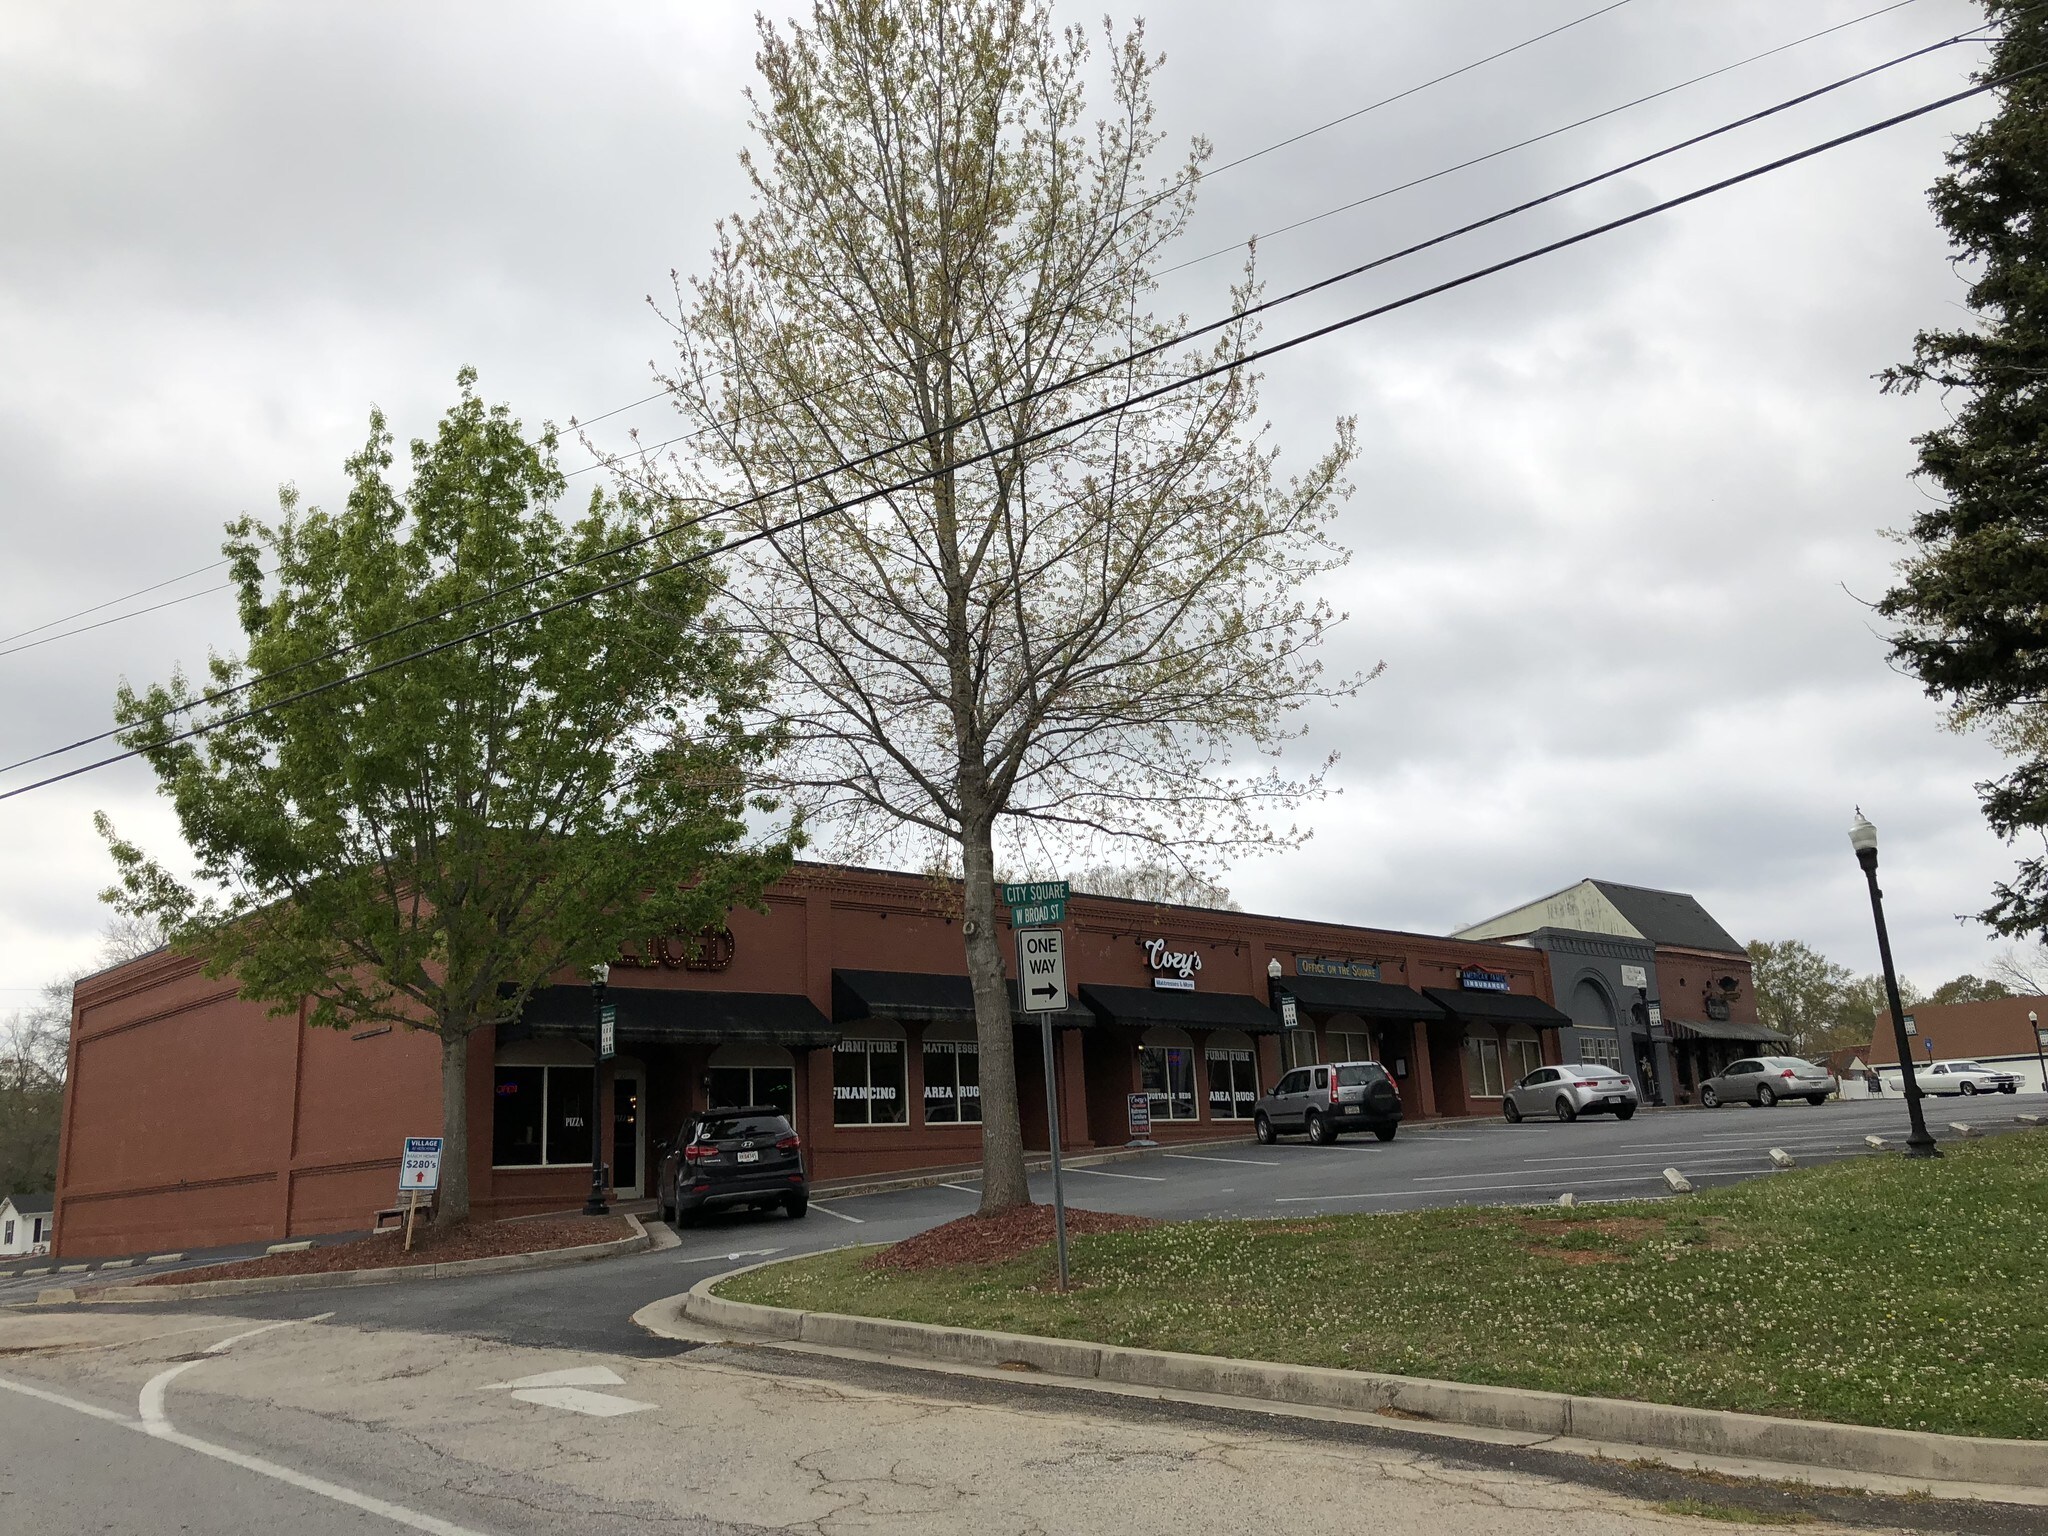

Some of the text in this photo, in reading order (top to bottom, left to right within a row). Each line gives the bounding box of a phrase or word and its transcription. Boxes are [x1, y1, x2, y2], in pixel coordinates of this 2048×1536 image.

[1006, 883, 1066, 902] CITY SQUARE
[1015, 904, 1059, 925] W BROAD ST
[1027, 938, 1058, 954] ONE
[1145, 938, 1202, 978] Cozy's
[1029, 959, 1056, 975] WAY
[1465, 979, 1506, 990] INSURANCE
[922, 1042, 979, 1054] MATTRESSE
[1205, 1050, 1250, 1062] FURNITURE
[924, 1085, 980, 1098] AREA RUG
[1209, 1091, 1255, 1102] AREA RUGS
[565, 1117, 584, 1127] PIZZA
[406, 1160, 437, 1169] $280's
